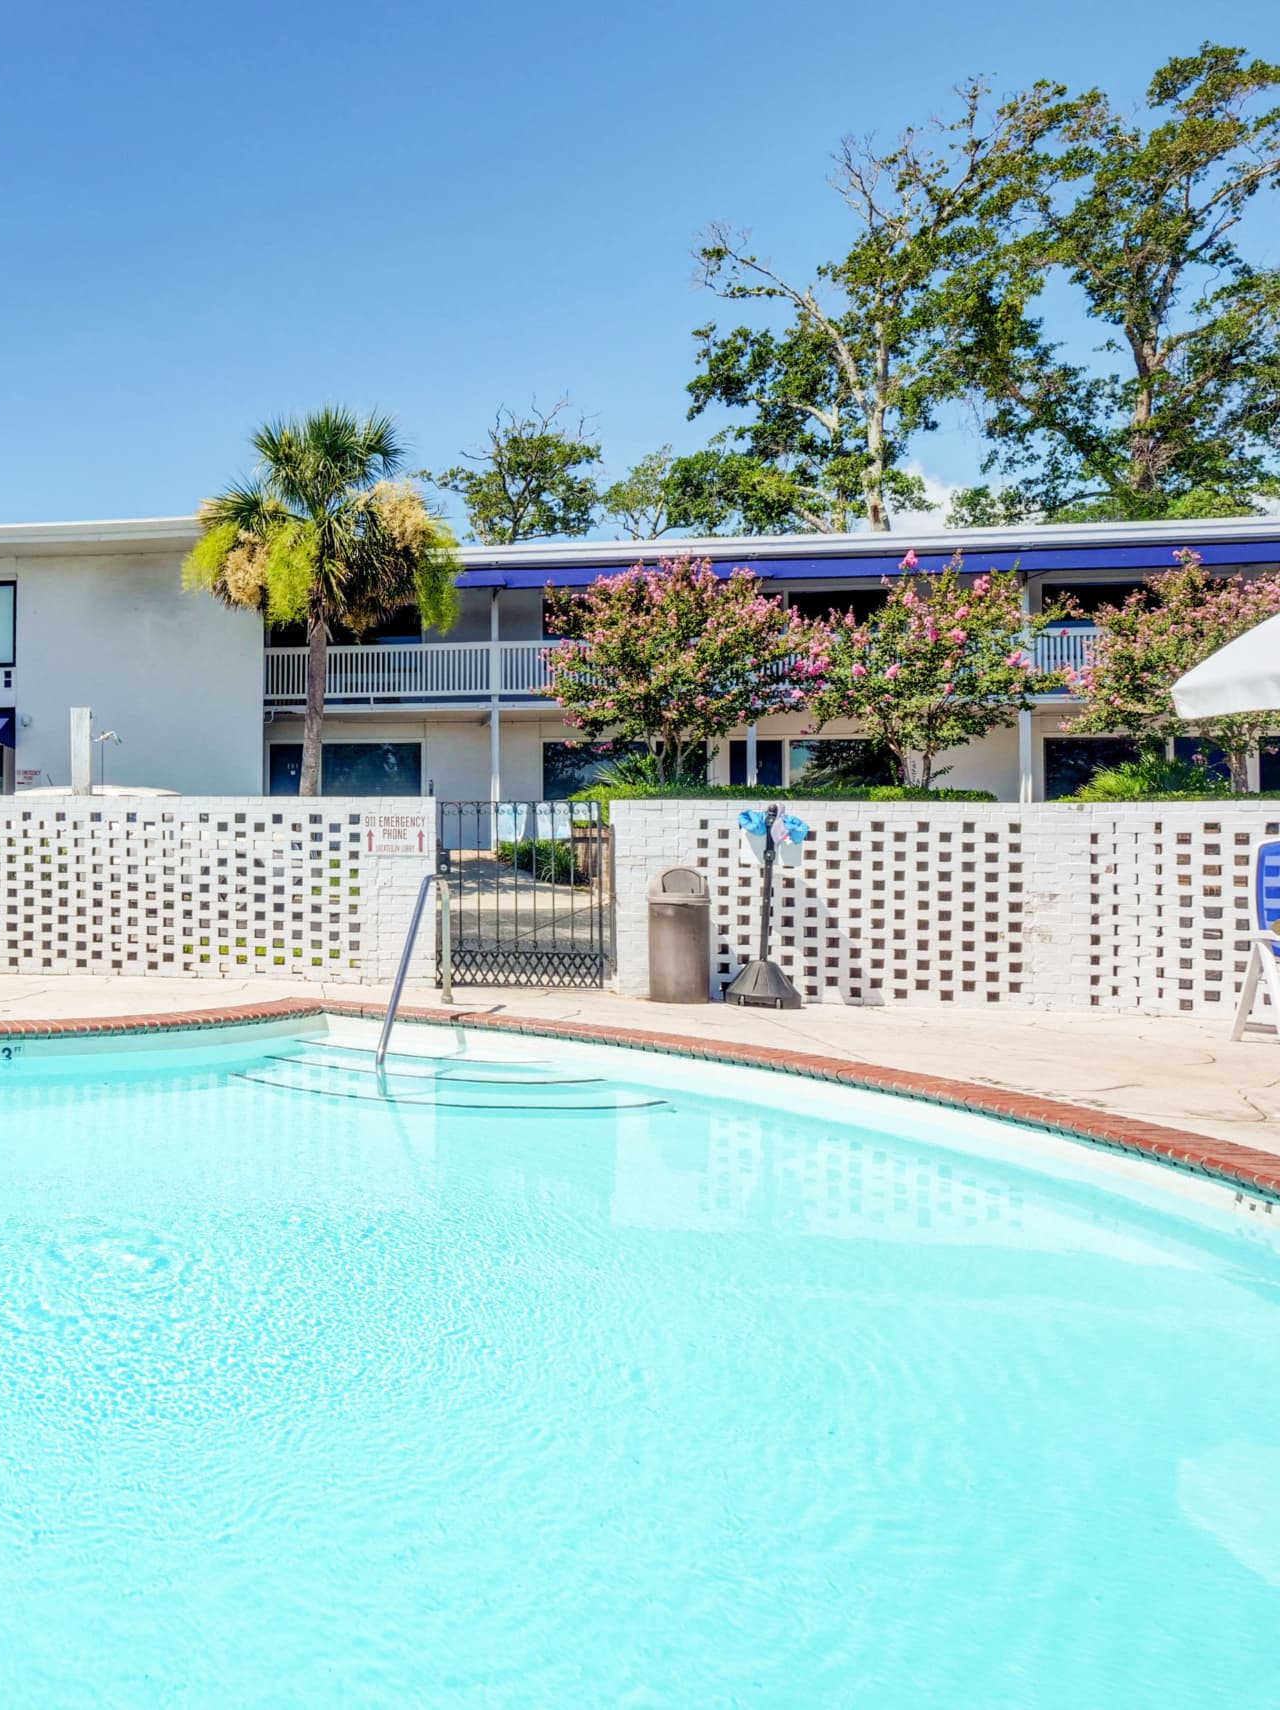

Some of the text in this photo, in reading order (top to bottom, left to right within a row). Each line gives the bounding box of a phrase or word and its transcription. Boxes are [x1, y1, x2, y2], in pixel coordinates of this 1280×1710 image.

[364, 816, 426, 828] 911 EMERGENCY
[382, 828, 408, 840] PHONE
